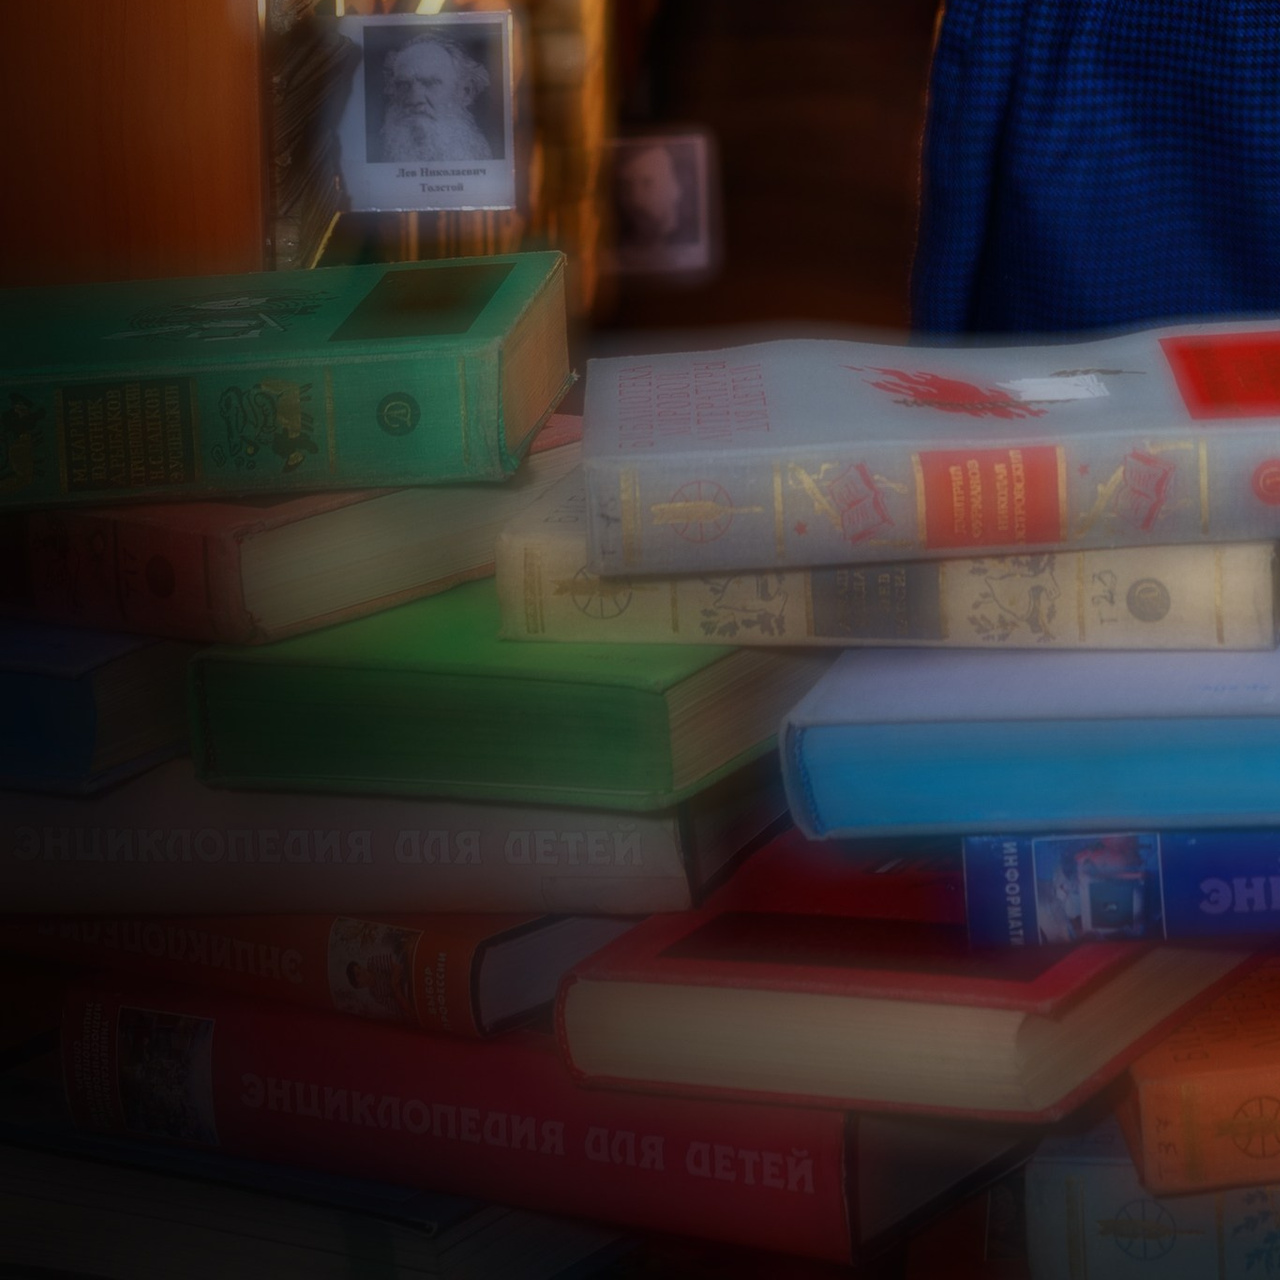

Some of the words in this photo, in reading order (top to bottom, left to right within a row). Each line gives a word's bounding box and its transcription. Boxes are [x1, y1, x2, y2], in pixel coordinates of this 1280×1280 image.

[618, 365, 654, 448] БИБЛИОТЕКА
[657, 372, 692, 437] МИРОВОЙ
[693, 360, 732, 443] ЛИТЕРАТУРЫ
[949, 465, 966, 536] ДМИТРИЙ
[967, 458, 984, 538] ФУРМАНОВ
[994, 463, 1009, 530] НИКОЛАЙ
[12, 825, 373, 865] ЭНЦИКЛОПЕДИЯ
[393, 828, 483, 865] ДЛЯ
[504, 823, 643, 866] ДЕТЕЙ
[239, 1073, 566, 1156] ЭНЦИКЛОПЕДИЯ
[583, 1134, 666, 1173] ДЛЯ
[685, 1141, 816, 1196] ДЕТЕЙ
